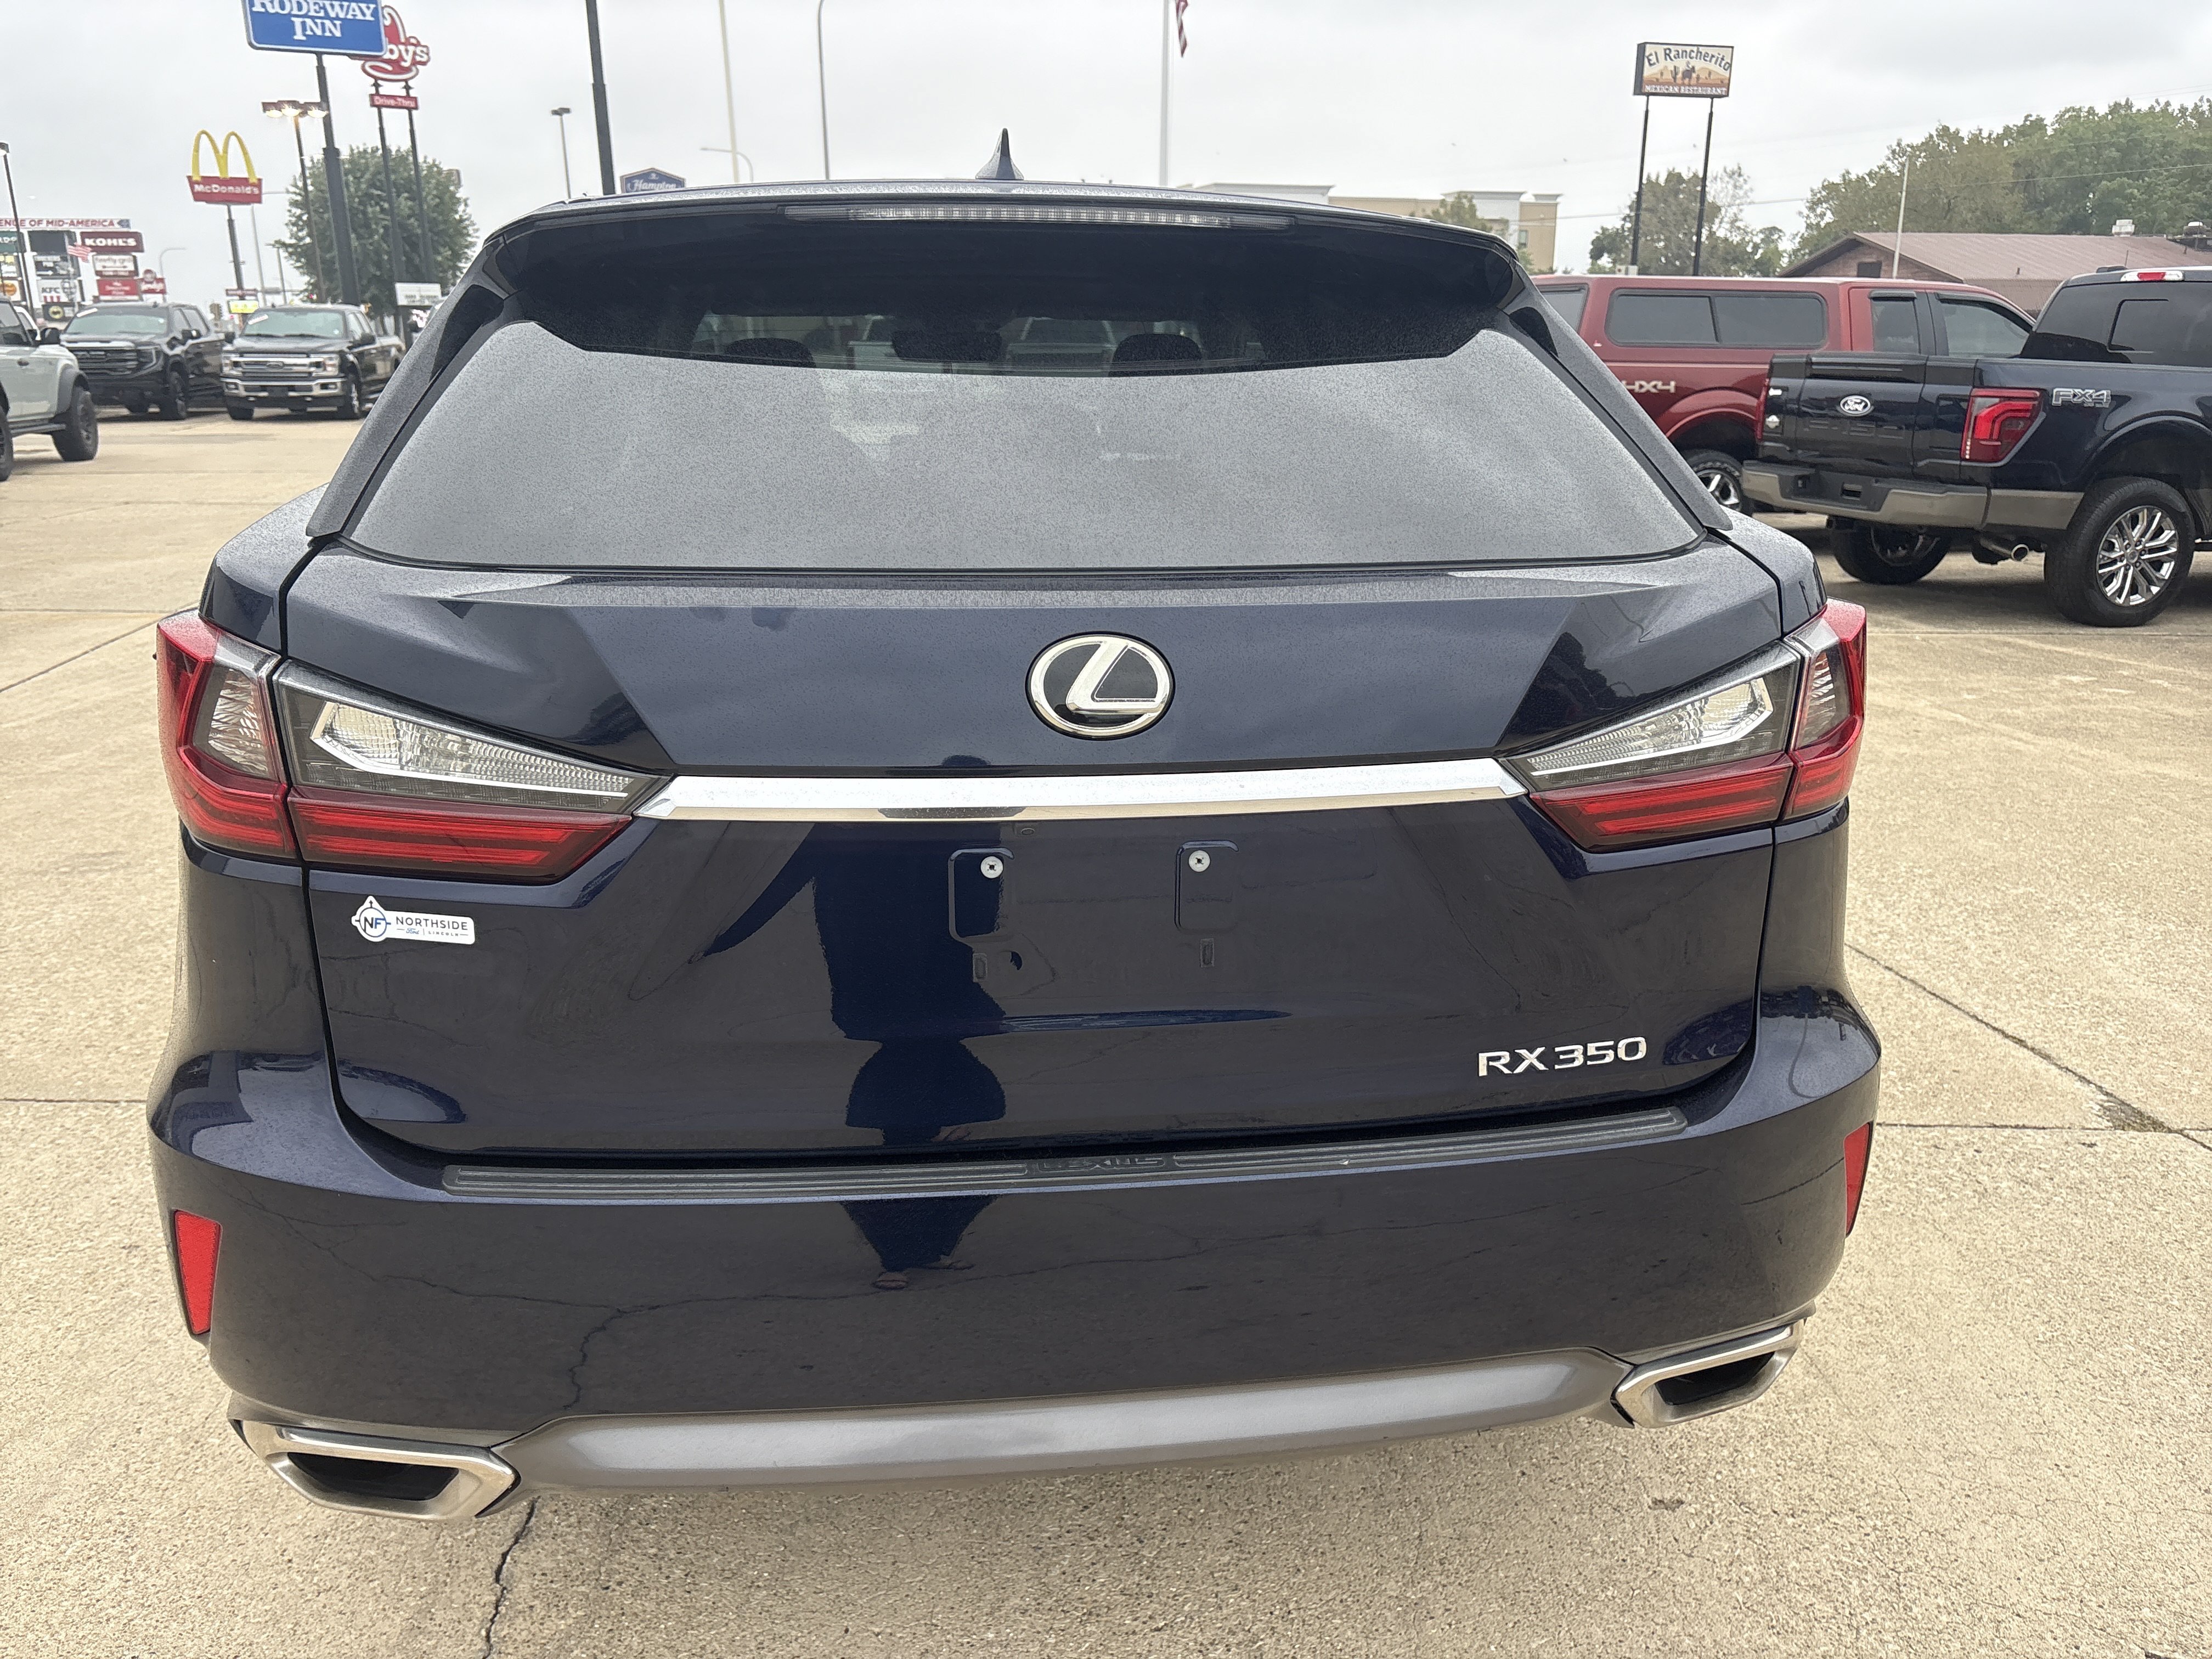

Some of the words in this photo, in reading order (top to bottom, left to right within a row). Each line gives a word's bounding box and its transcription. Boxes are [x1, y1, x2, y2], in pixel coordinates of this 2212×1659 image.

[252, 0, 376, 21] RODEWAY
[290, 17, 342, 41] INN
[382, 36, 429, 67] by's
[1645, 50, 1660, 67] El
[1663, 46, 1731, 72] Rancherito
[1645, 84, 1680, 94] MEXICAN
[1680, 86, 1728, 95] RESTAURANT
[193, 184, 259, 194] McDonald's
[627, 179, 677, 191] Hampton
[1844, 398, 1866, 411] Ford
[2052, 388, 2111, 407] FX4
[396, 916, 468, 930] NORTHSIDE
